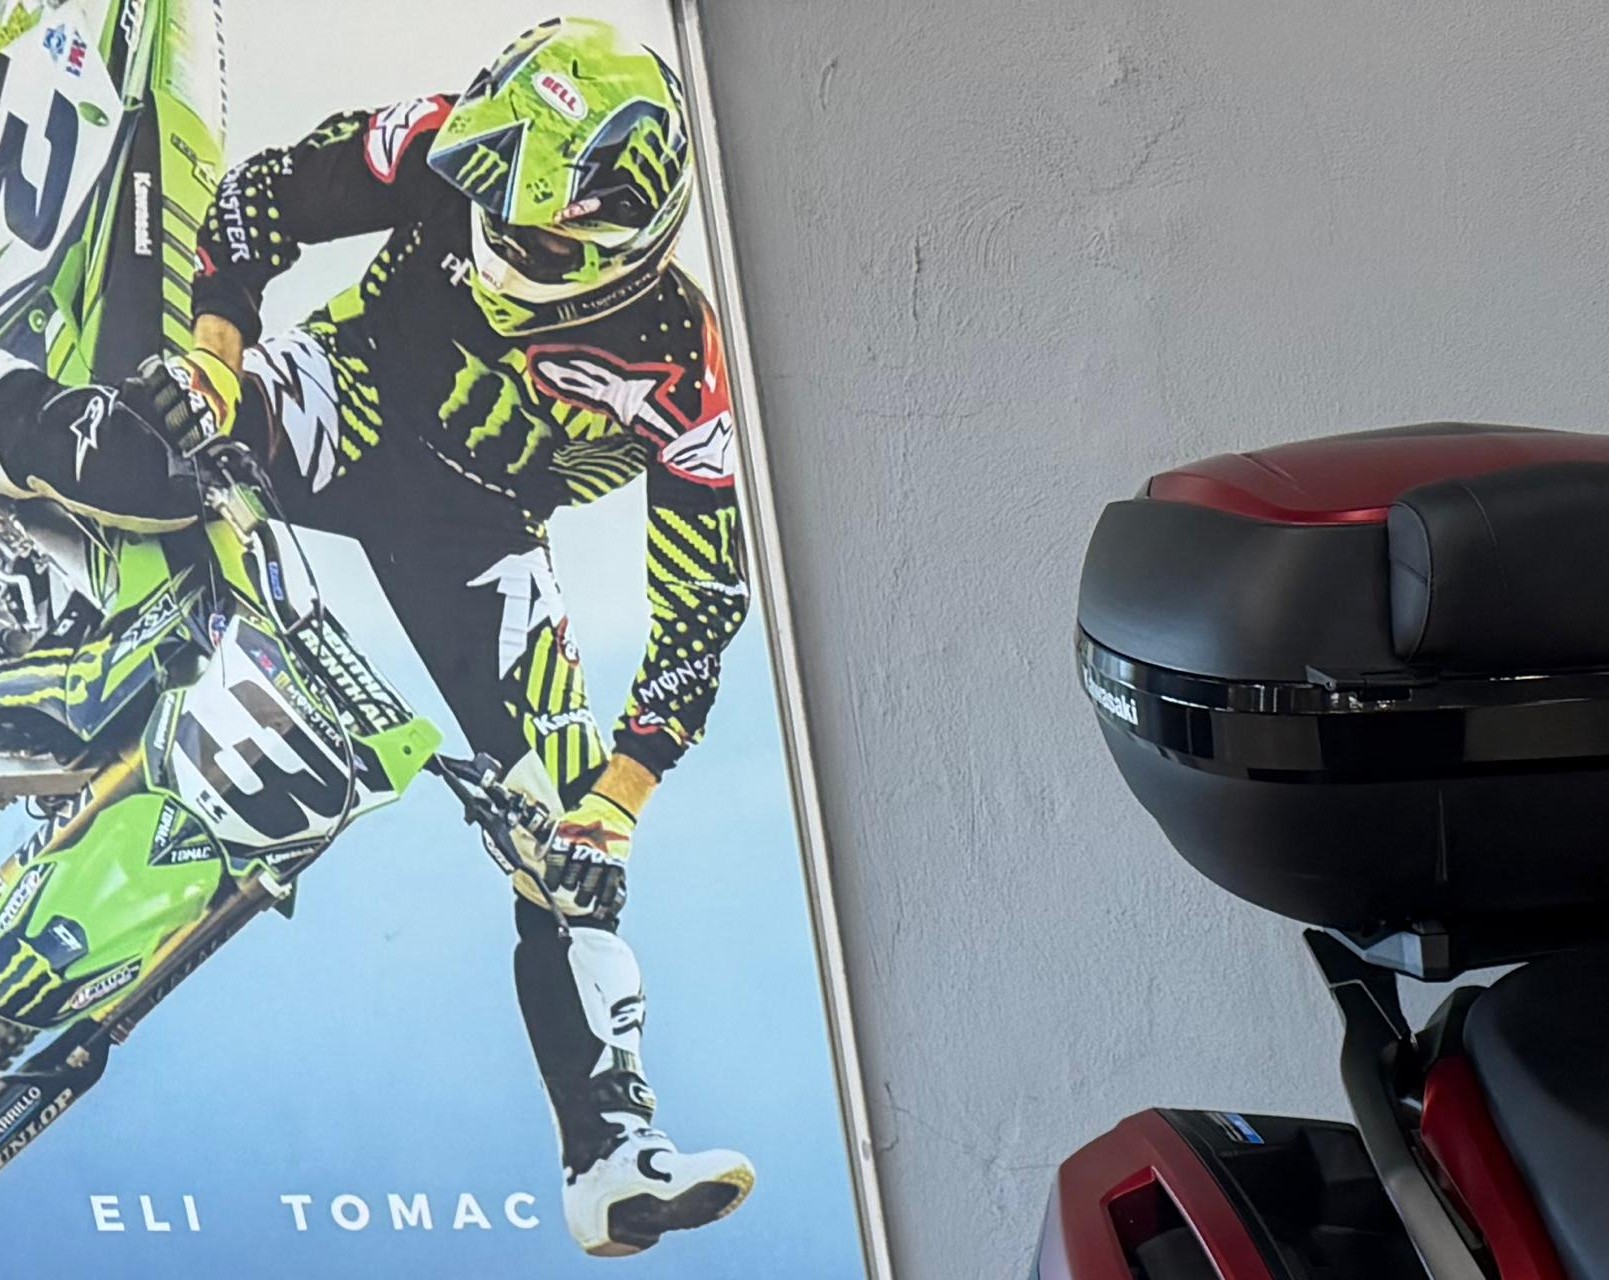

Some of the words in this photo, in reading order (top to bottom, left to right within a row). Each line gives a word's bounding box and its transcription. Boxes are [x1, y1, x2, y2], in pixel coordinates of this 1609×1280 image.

[541, 76, 578, 112] BELL
[171, 846, 211, 863] TOMAC
[92, 1194, 201, 1232] ELI
[281, 1193, 541, 1231] TOMAC
